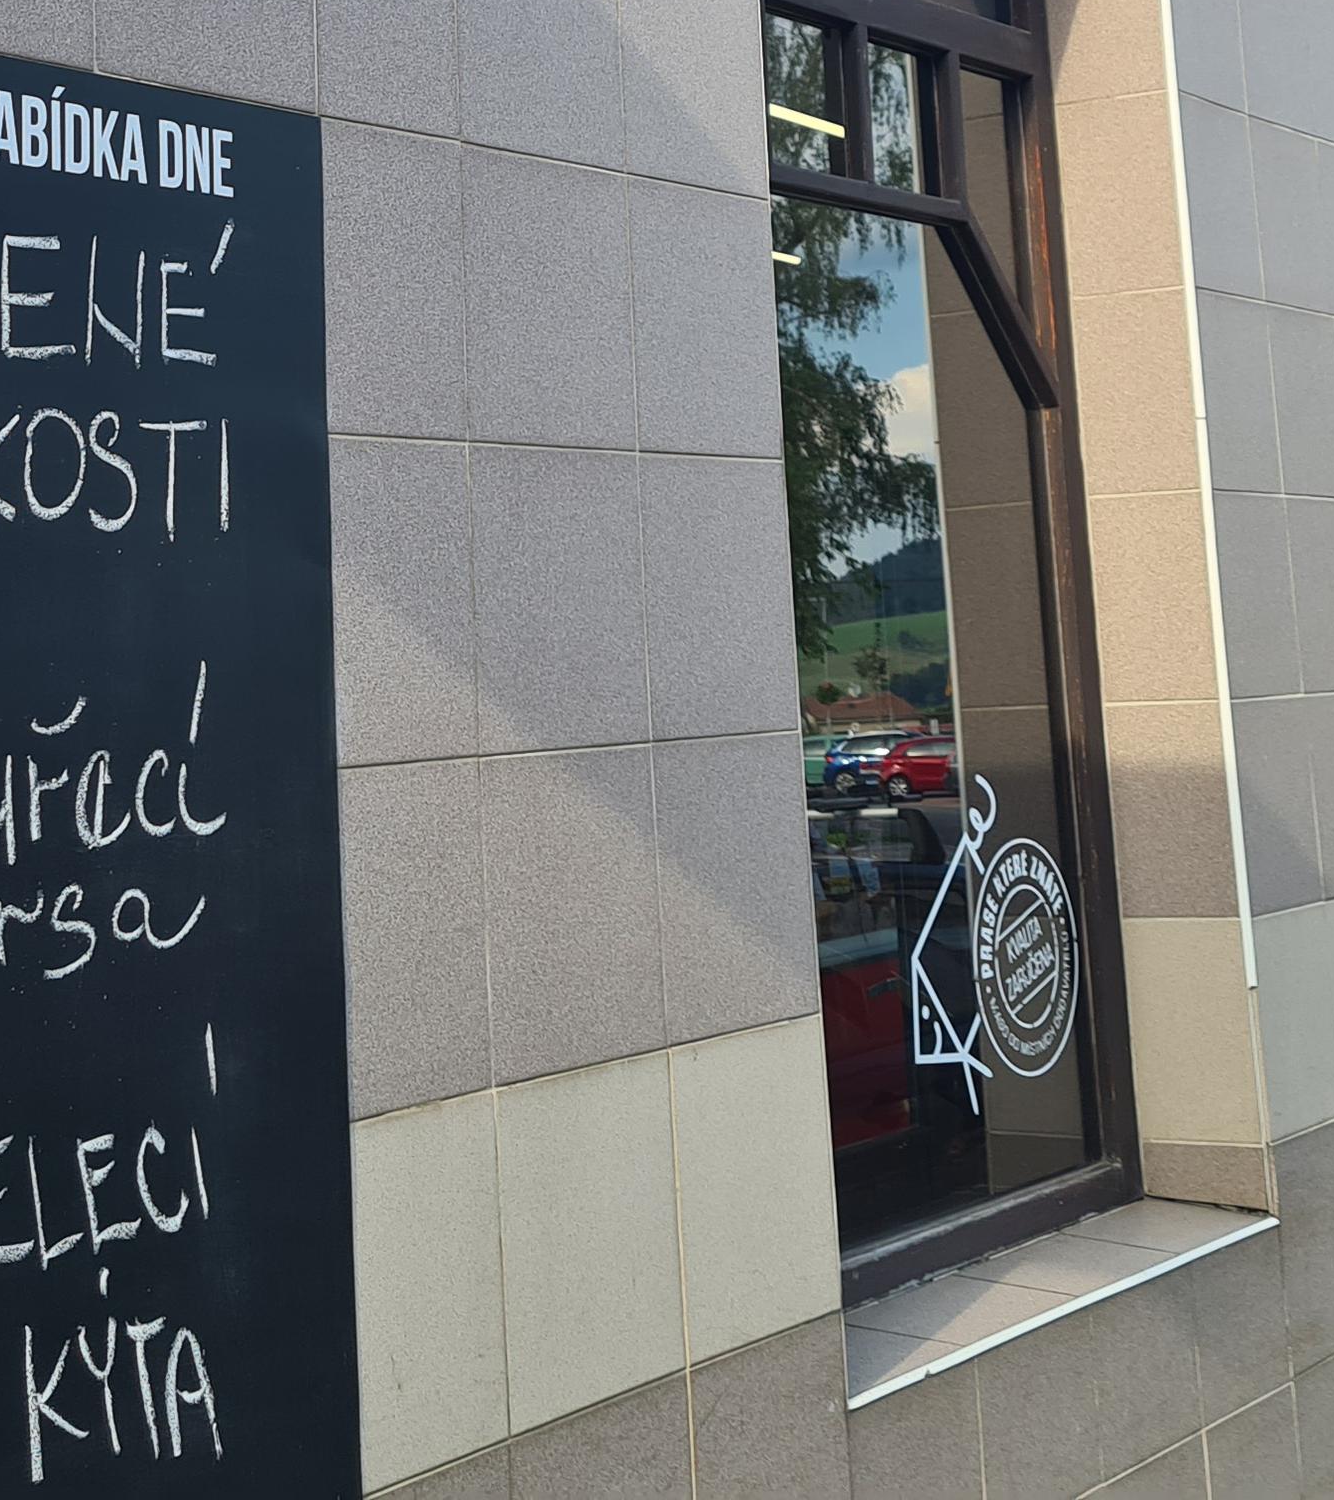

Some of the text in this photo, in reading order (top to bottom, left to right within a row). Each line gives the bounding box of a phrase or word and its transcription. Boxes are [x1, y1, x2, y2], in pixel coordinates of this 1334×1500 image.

[158, 119, 235, 197] DNE
[980, 849, 1064, 979] PRASE KTERÉ ZNÁTE
[1005, 915, 1044, 964] KVALITA
[24, 1267, 223, 1482] KÝTA
